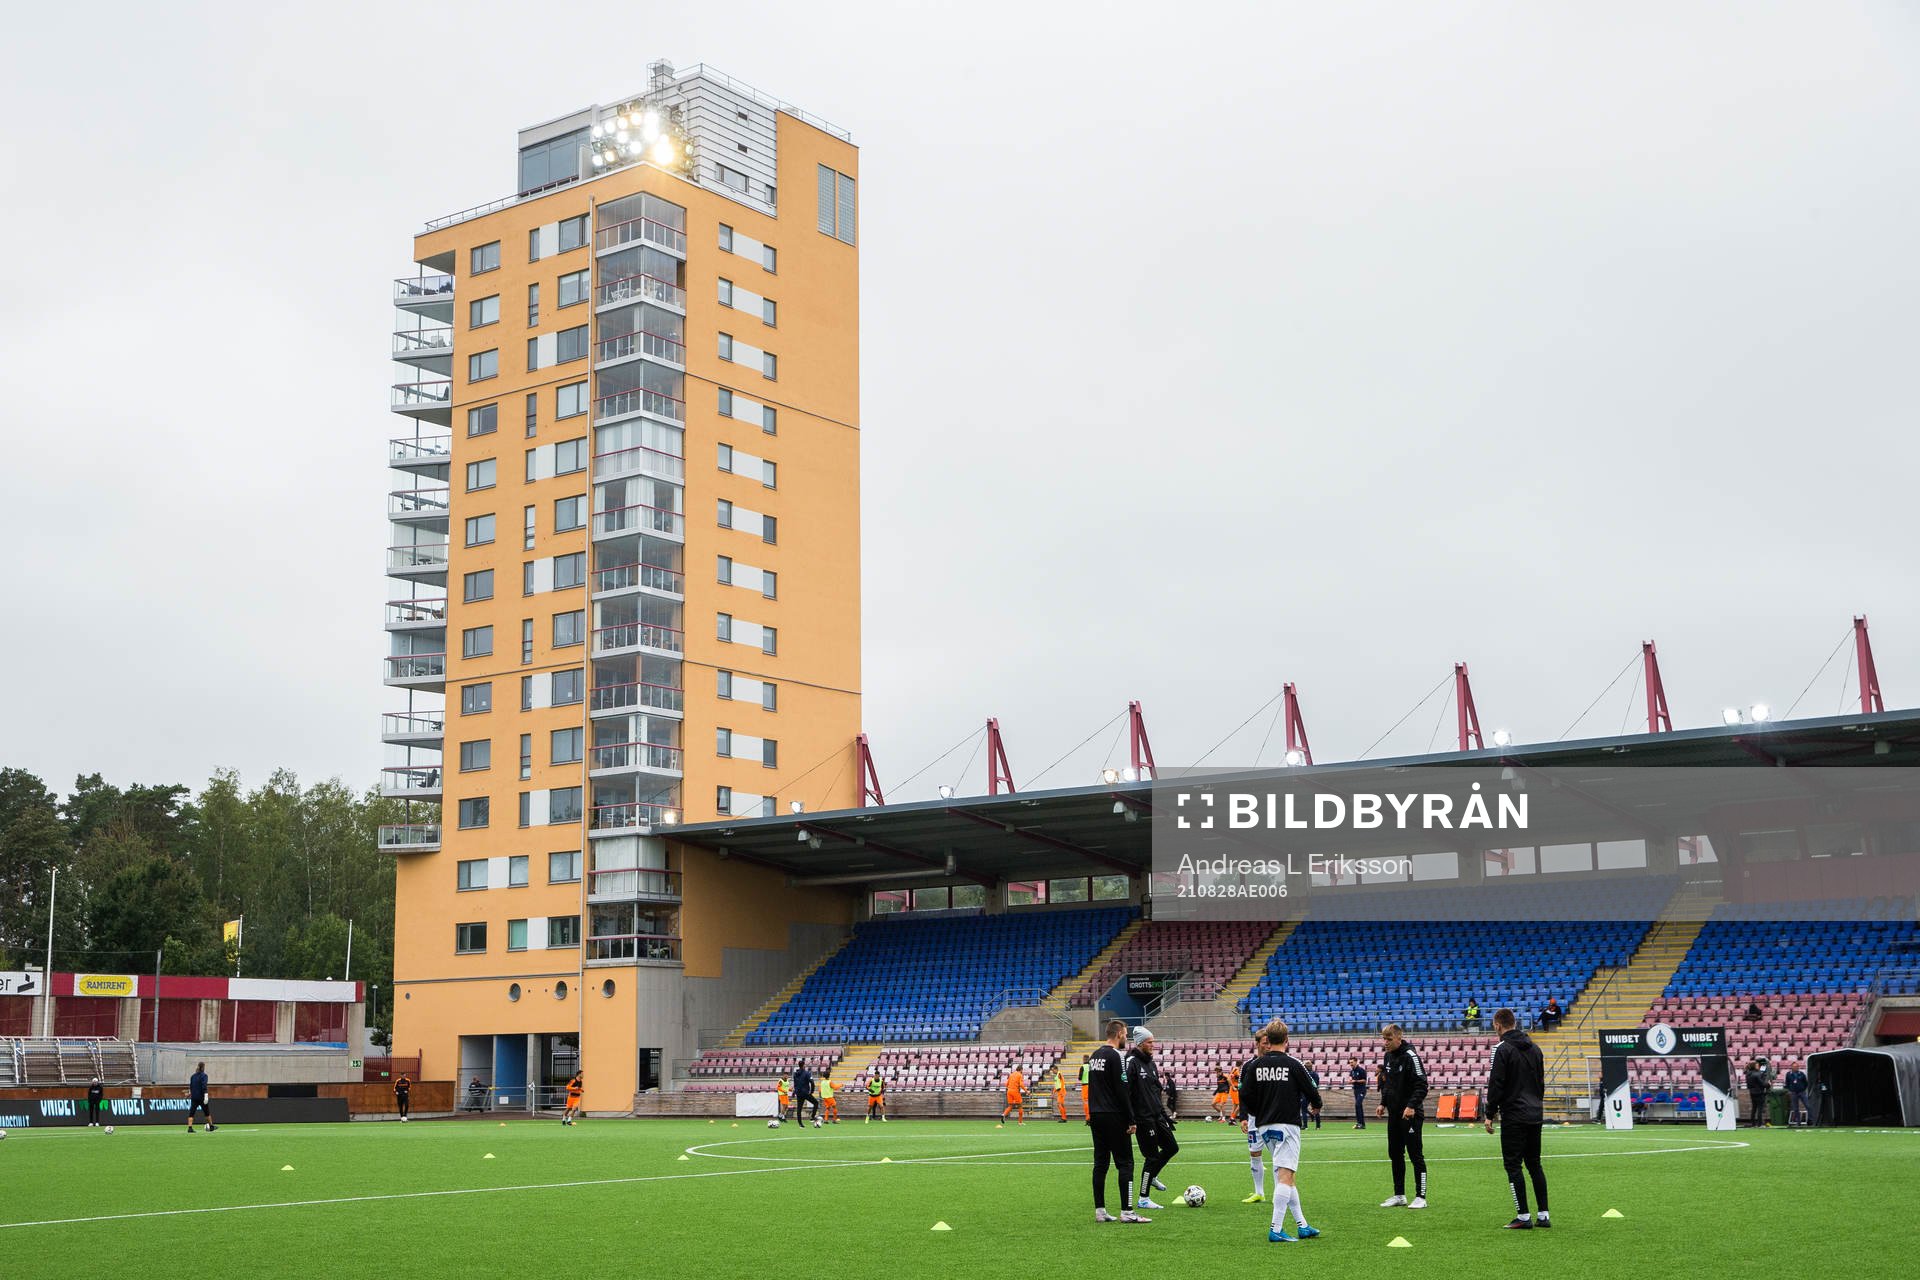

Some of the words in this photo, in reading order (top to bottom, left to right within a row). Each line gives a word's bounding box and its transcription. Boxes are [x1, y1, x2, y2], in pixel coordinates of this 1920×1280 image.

[86, 981, 126, 990] RAMIRENT
[1605, 1035, 1640, 1044] UNIBET
[1682, 1033, 1719, 1042] UNIBET
[1256, 1067, 1289, 1081] BRAGE
[1613, 1100, 1623, 1112] U
[1714, 1100, 1724, 1112] U
